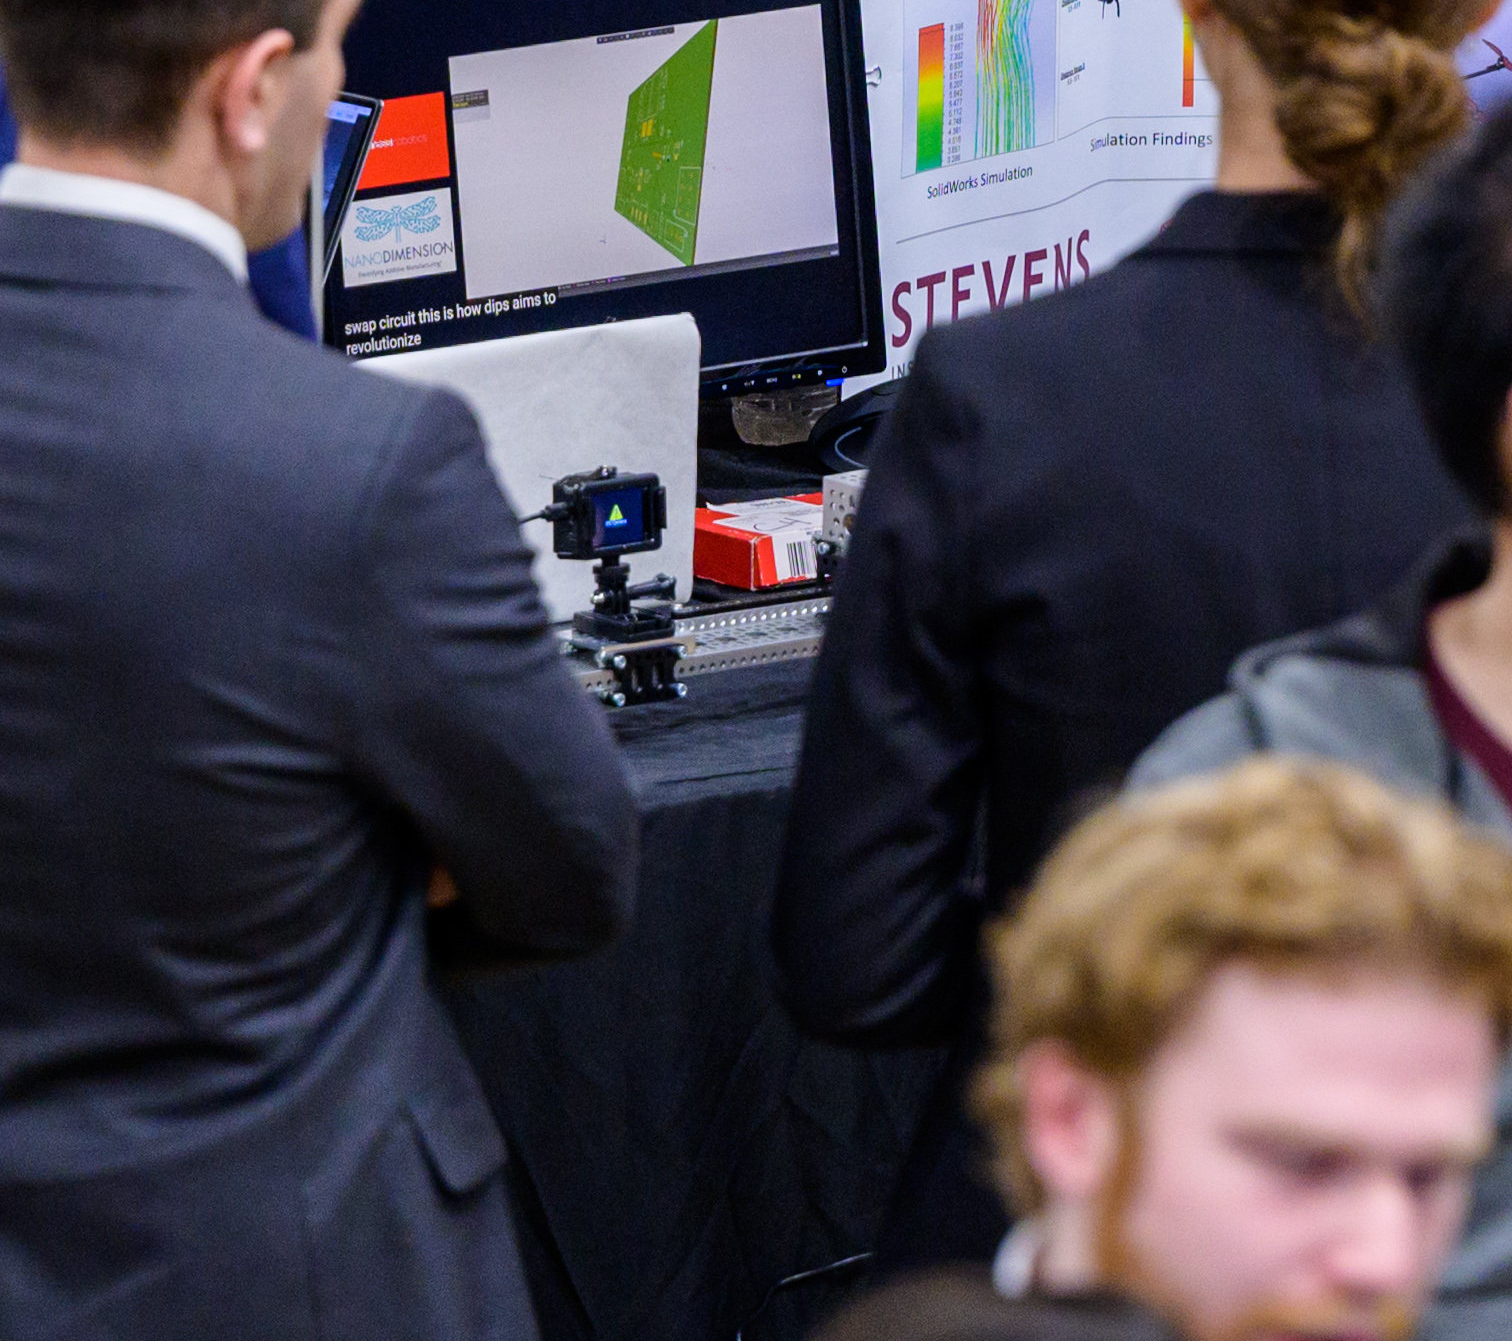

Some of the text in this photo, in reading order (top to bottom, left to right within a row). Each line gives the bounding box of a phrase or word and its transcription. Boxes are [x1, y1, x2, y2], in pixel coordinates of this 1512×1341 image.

[1090, 131, 1212, 152] Simulation Findings
[927, 165, 1033, 199] SolidWorks Simulation
[345, 241, 453, 268] NANODIMENSION
[345, 292, 556, 337] swap circuit this is how dips aims to
[346, 331, 422, 356] revolutionize
